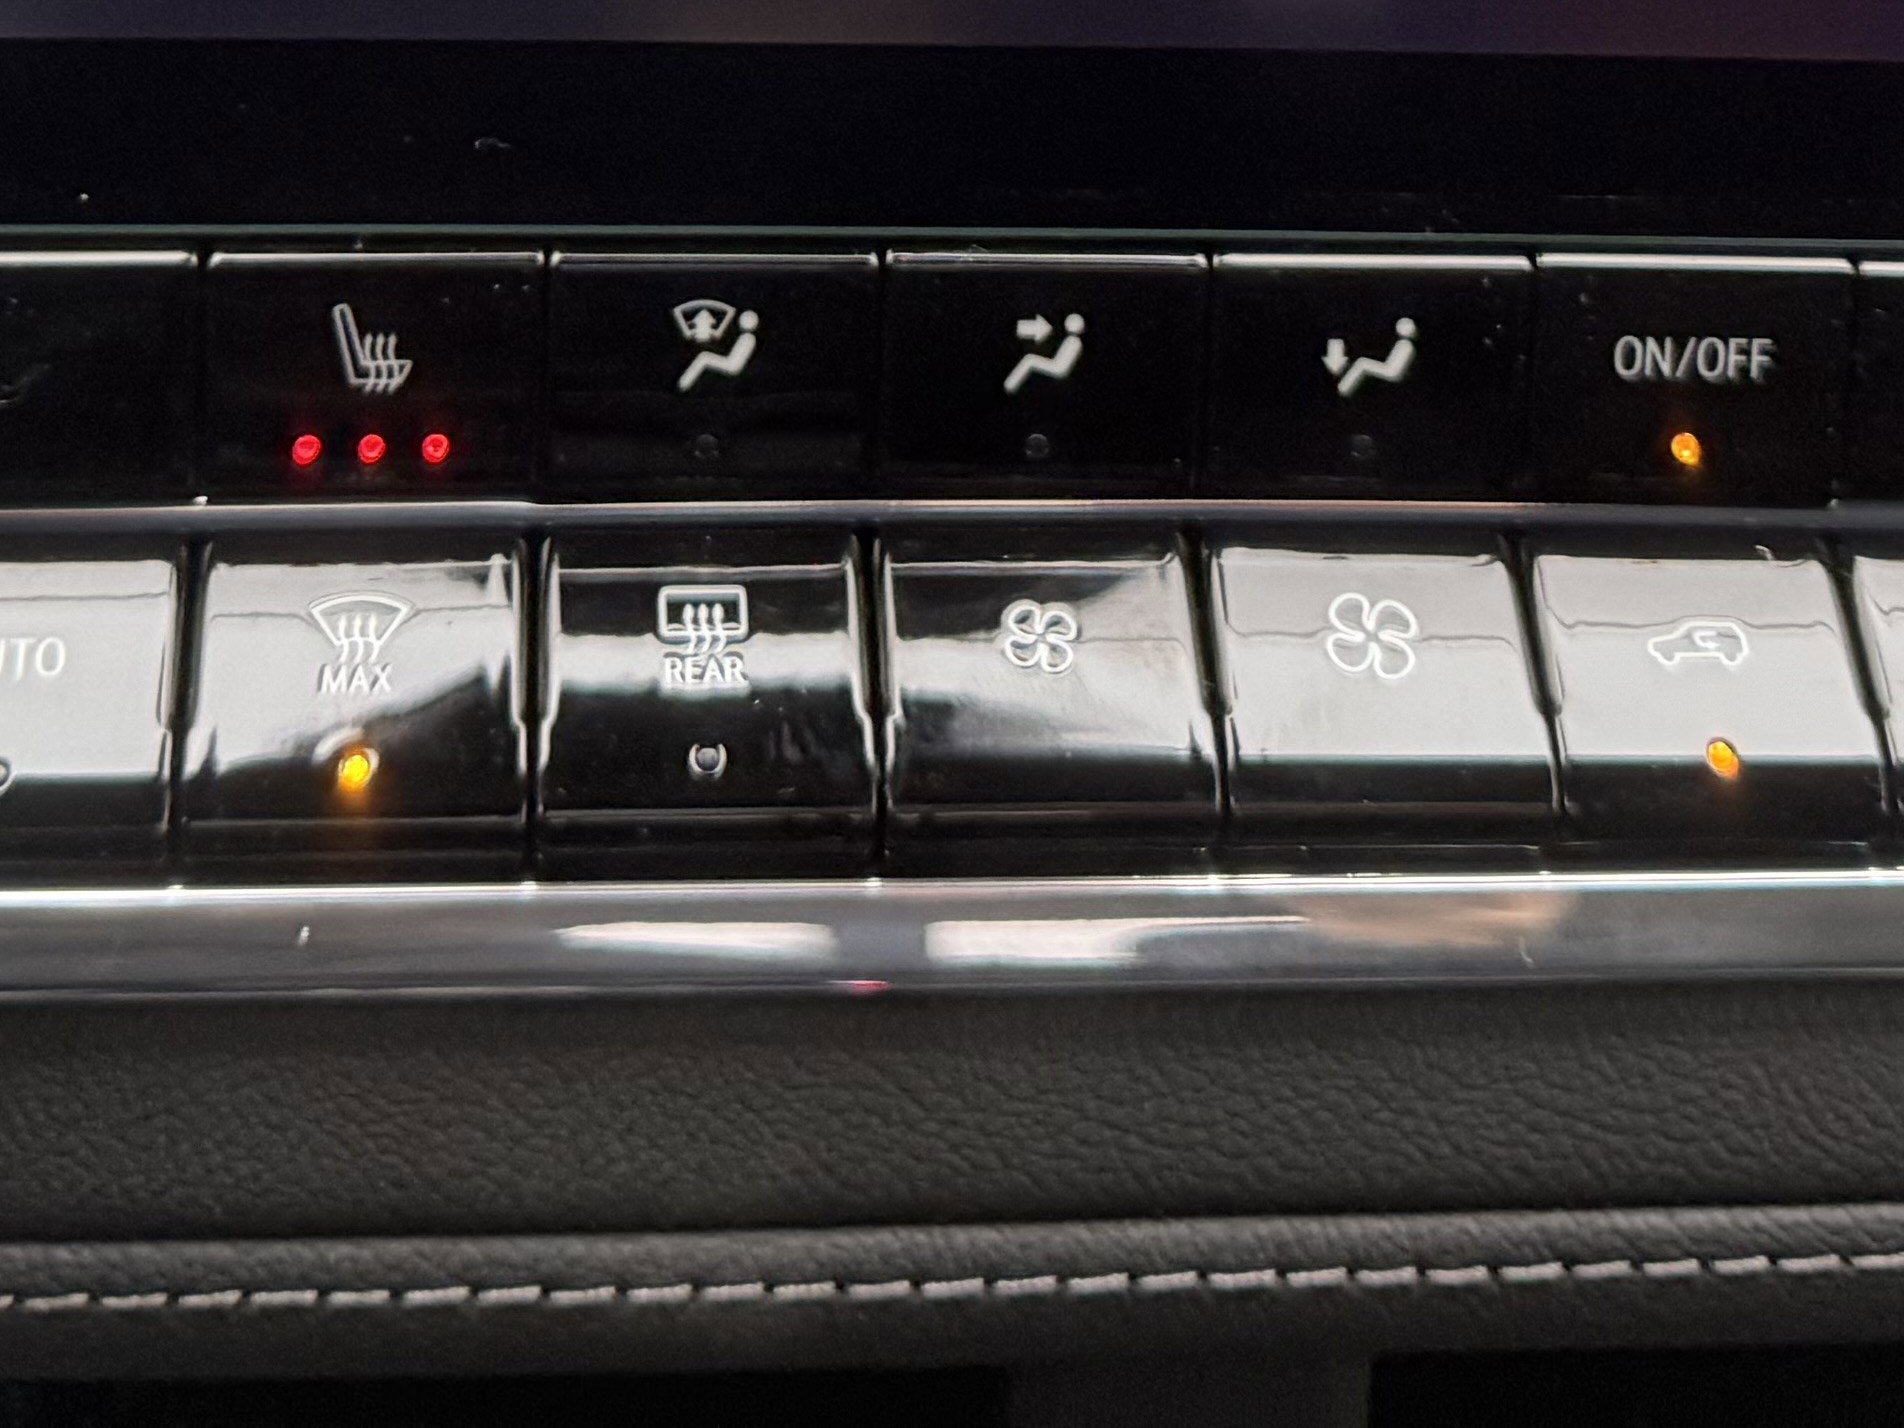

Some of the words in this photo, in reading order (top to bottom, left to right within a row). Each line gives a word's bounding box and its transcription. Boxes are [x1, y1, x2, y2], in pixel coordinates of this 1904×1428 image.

[1612, 335, 1776, 384] ON/OFF
[318, 662, 392, 694] MAX
[663, 655, 746, 687] REAR
